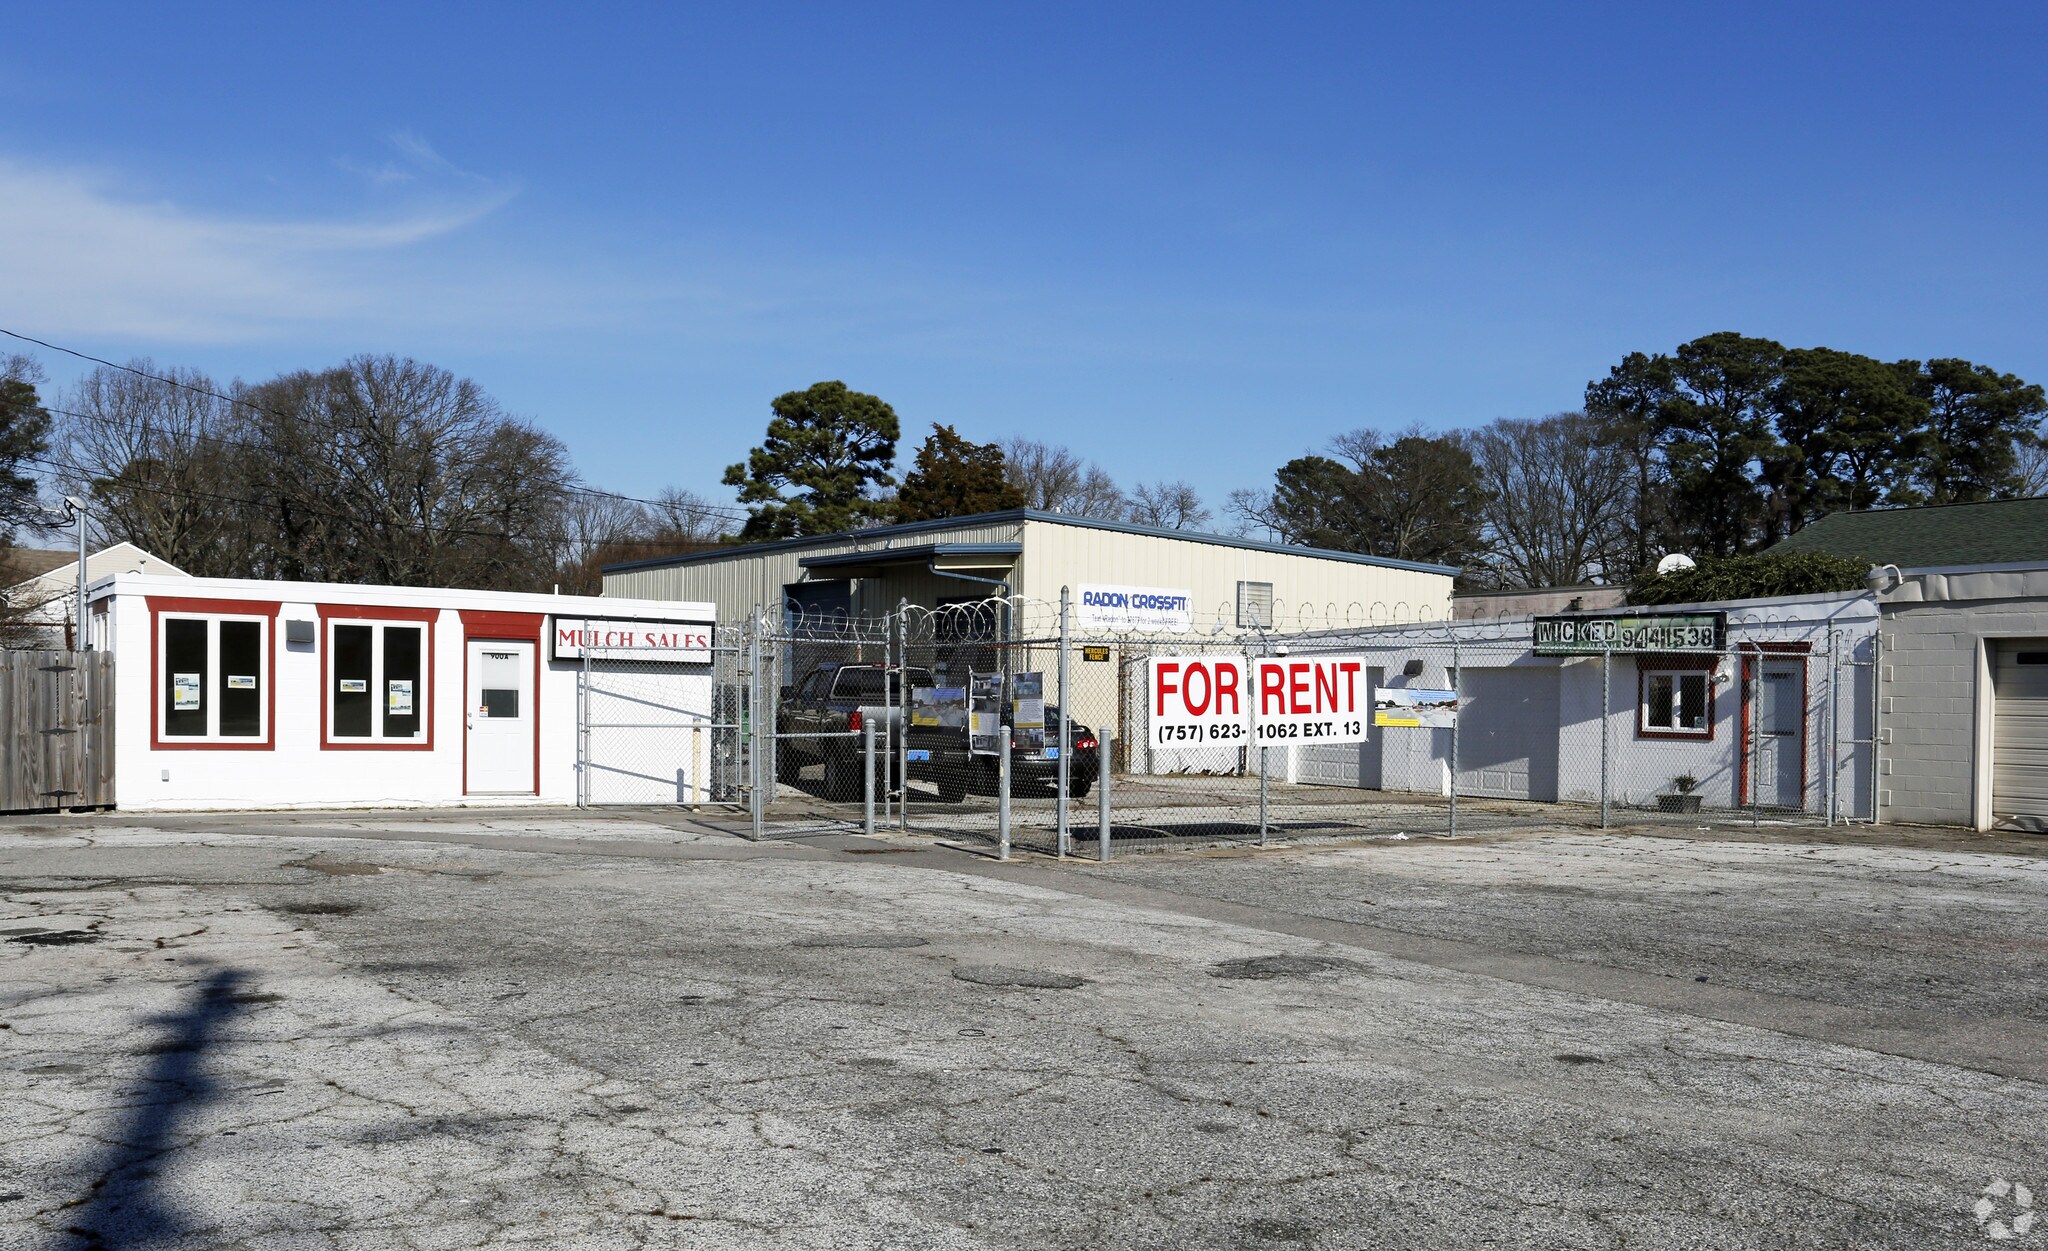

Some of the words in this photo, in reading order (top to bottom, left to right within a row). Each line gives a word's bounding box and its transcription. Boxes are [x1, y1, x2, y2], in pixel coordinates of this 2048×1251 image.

[1083, 591, 1128, 608] RADON
[1132, 594, 1186, 611] CROSSFIT
[559, 629, 633, 648] MULCH
[645, 633, 707, 651] SALES
[1539, 621, 1616, 642] WICKED
[1157, 662, 1239, 716] FOR
[1260, 663, 1361, 715] RENT
[1158, 725, 1203, 743] (757)
[1209, 724, 1247, 739] 623-
[1257, 724, 1298, 739] 1062
[1303, 722, 1337, 737] EXT.
[1344, 721, 1361, 735] 13
